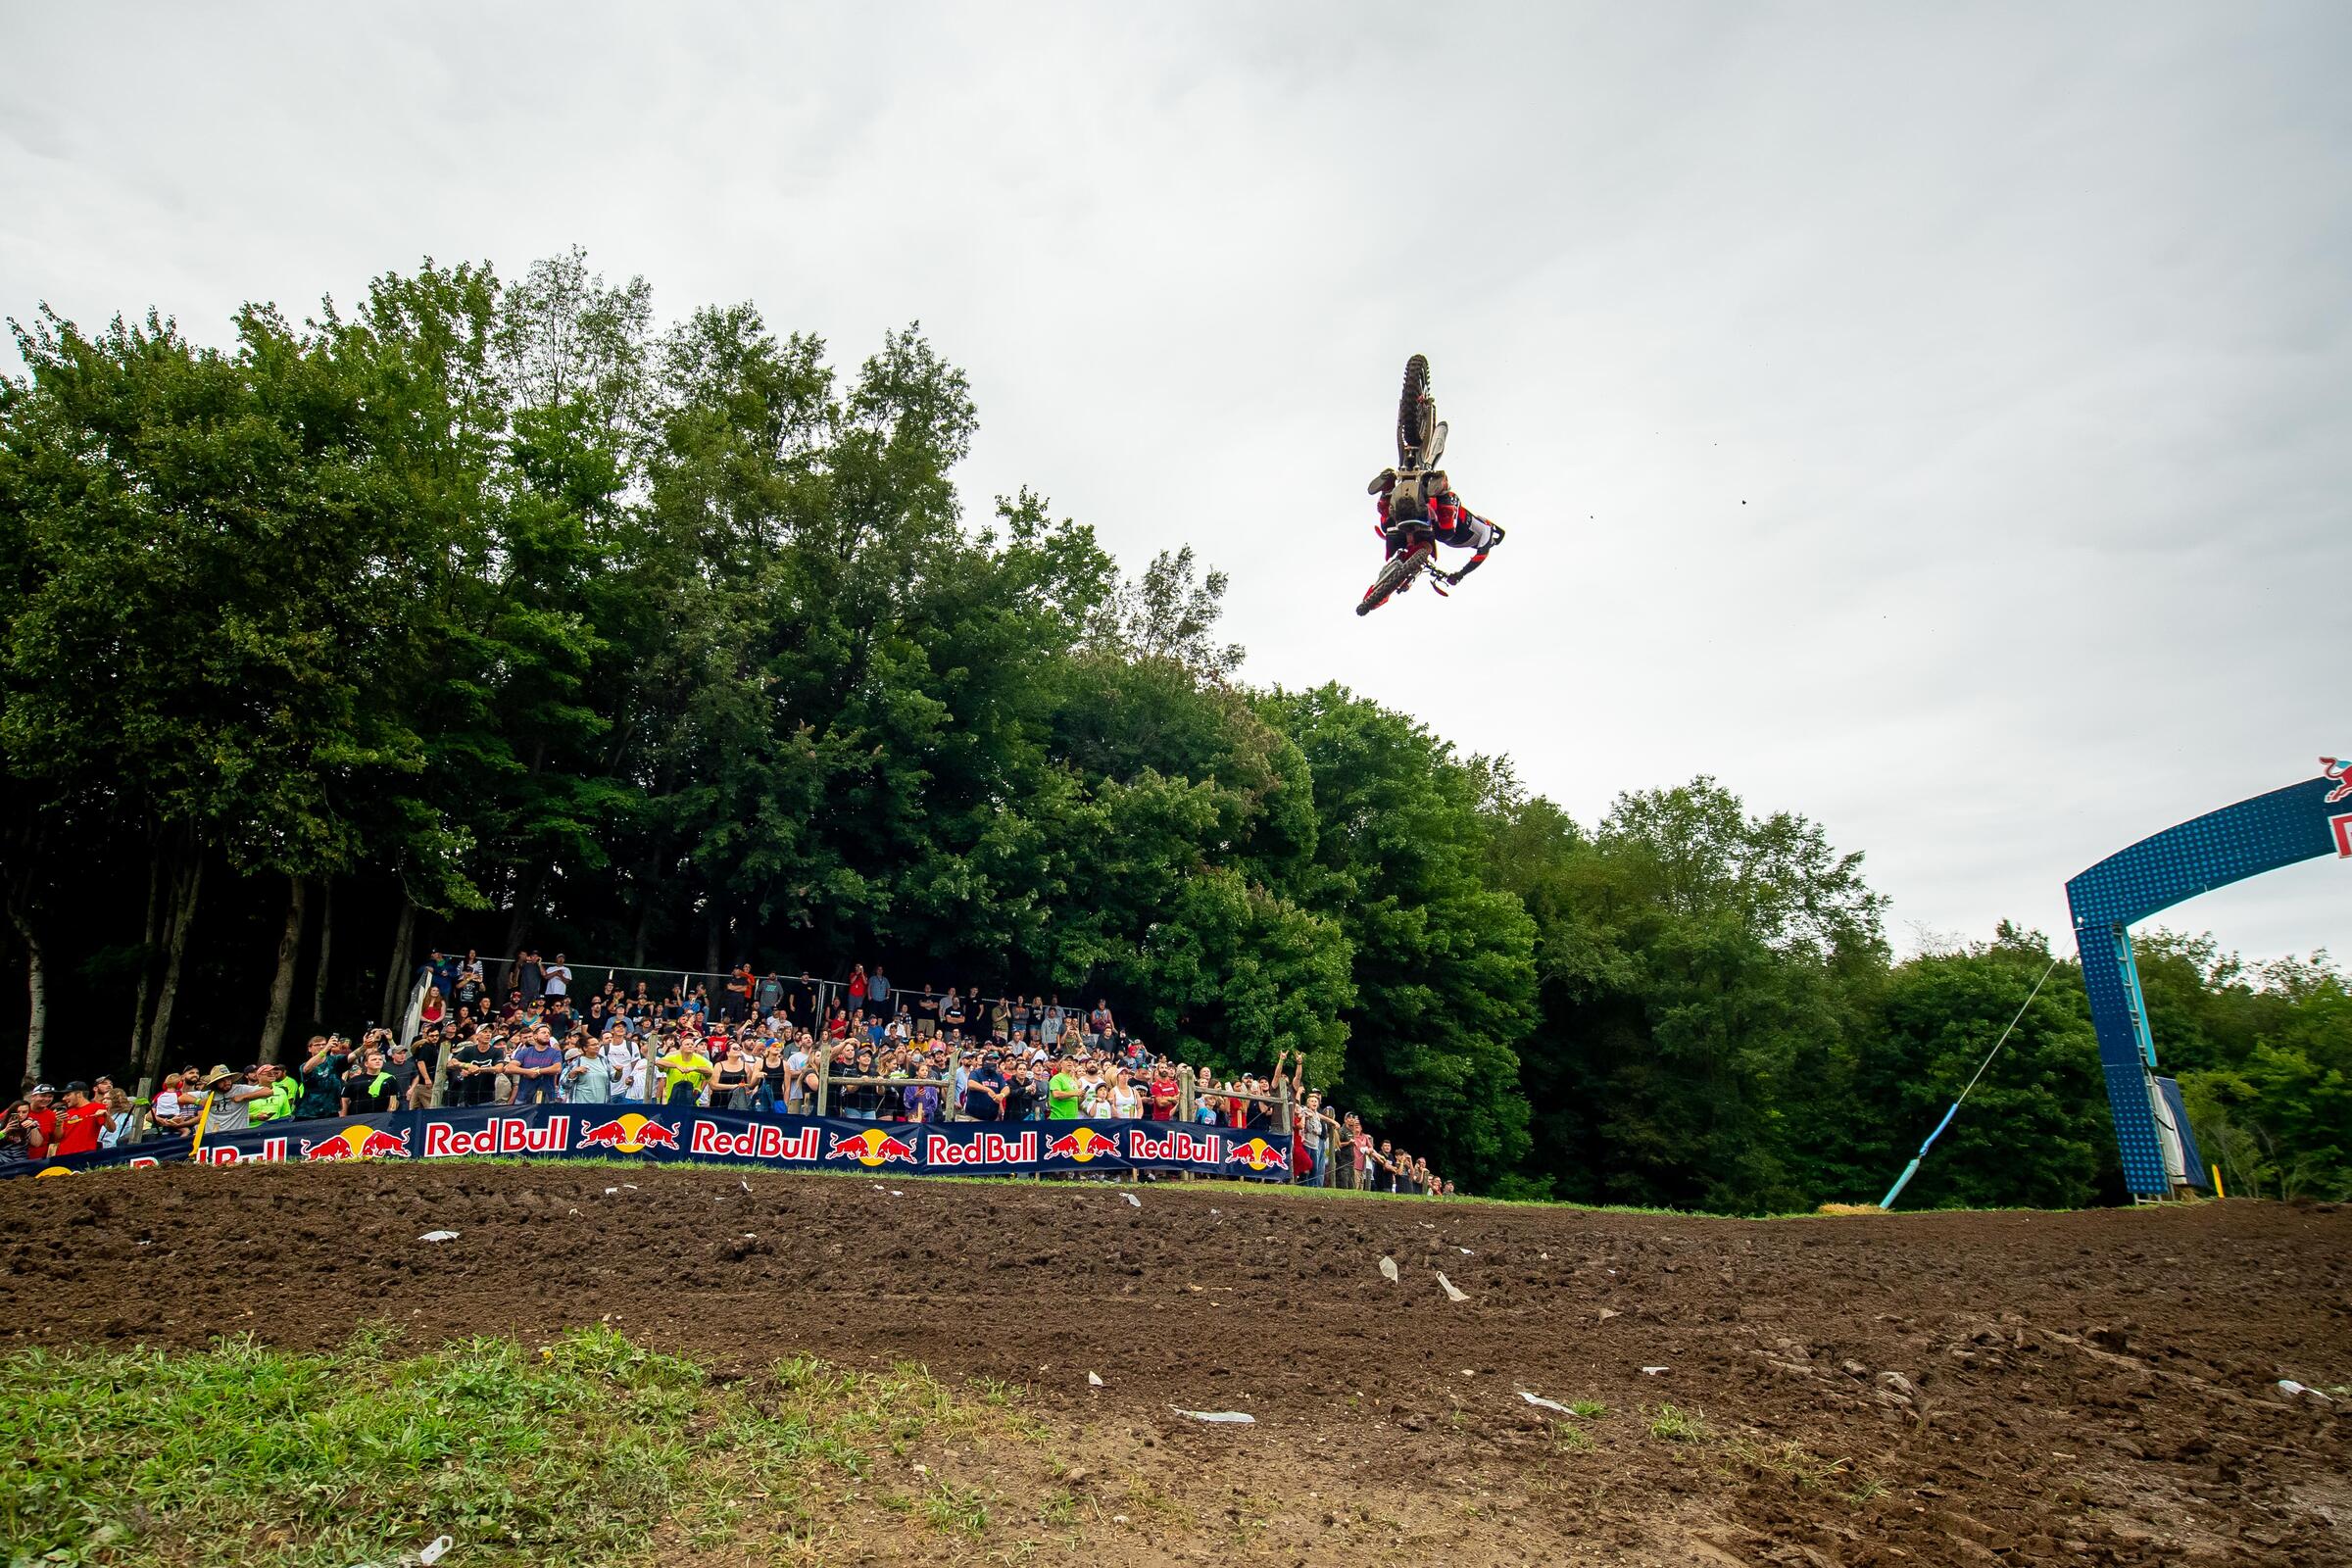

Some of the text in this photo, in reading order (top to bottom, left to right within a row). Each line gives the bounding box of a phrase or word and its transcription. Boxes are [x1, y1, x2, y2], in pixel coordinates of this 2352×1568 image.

[424, 1116, 570, 1156] Red Bull
[690, 1120, 820, 1160] Red Bull
[927, 1131, 1037, 1165] Red Bull
[1130, 1130, 1220, 1164] Red Bull
